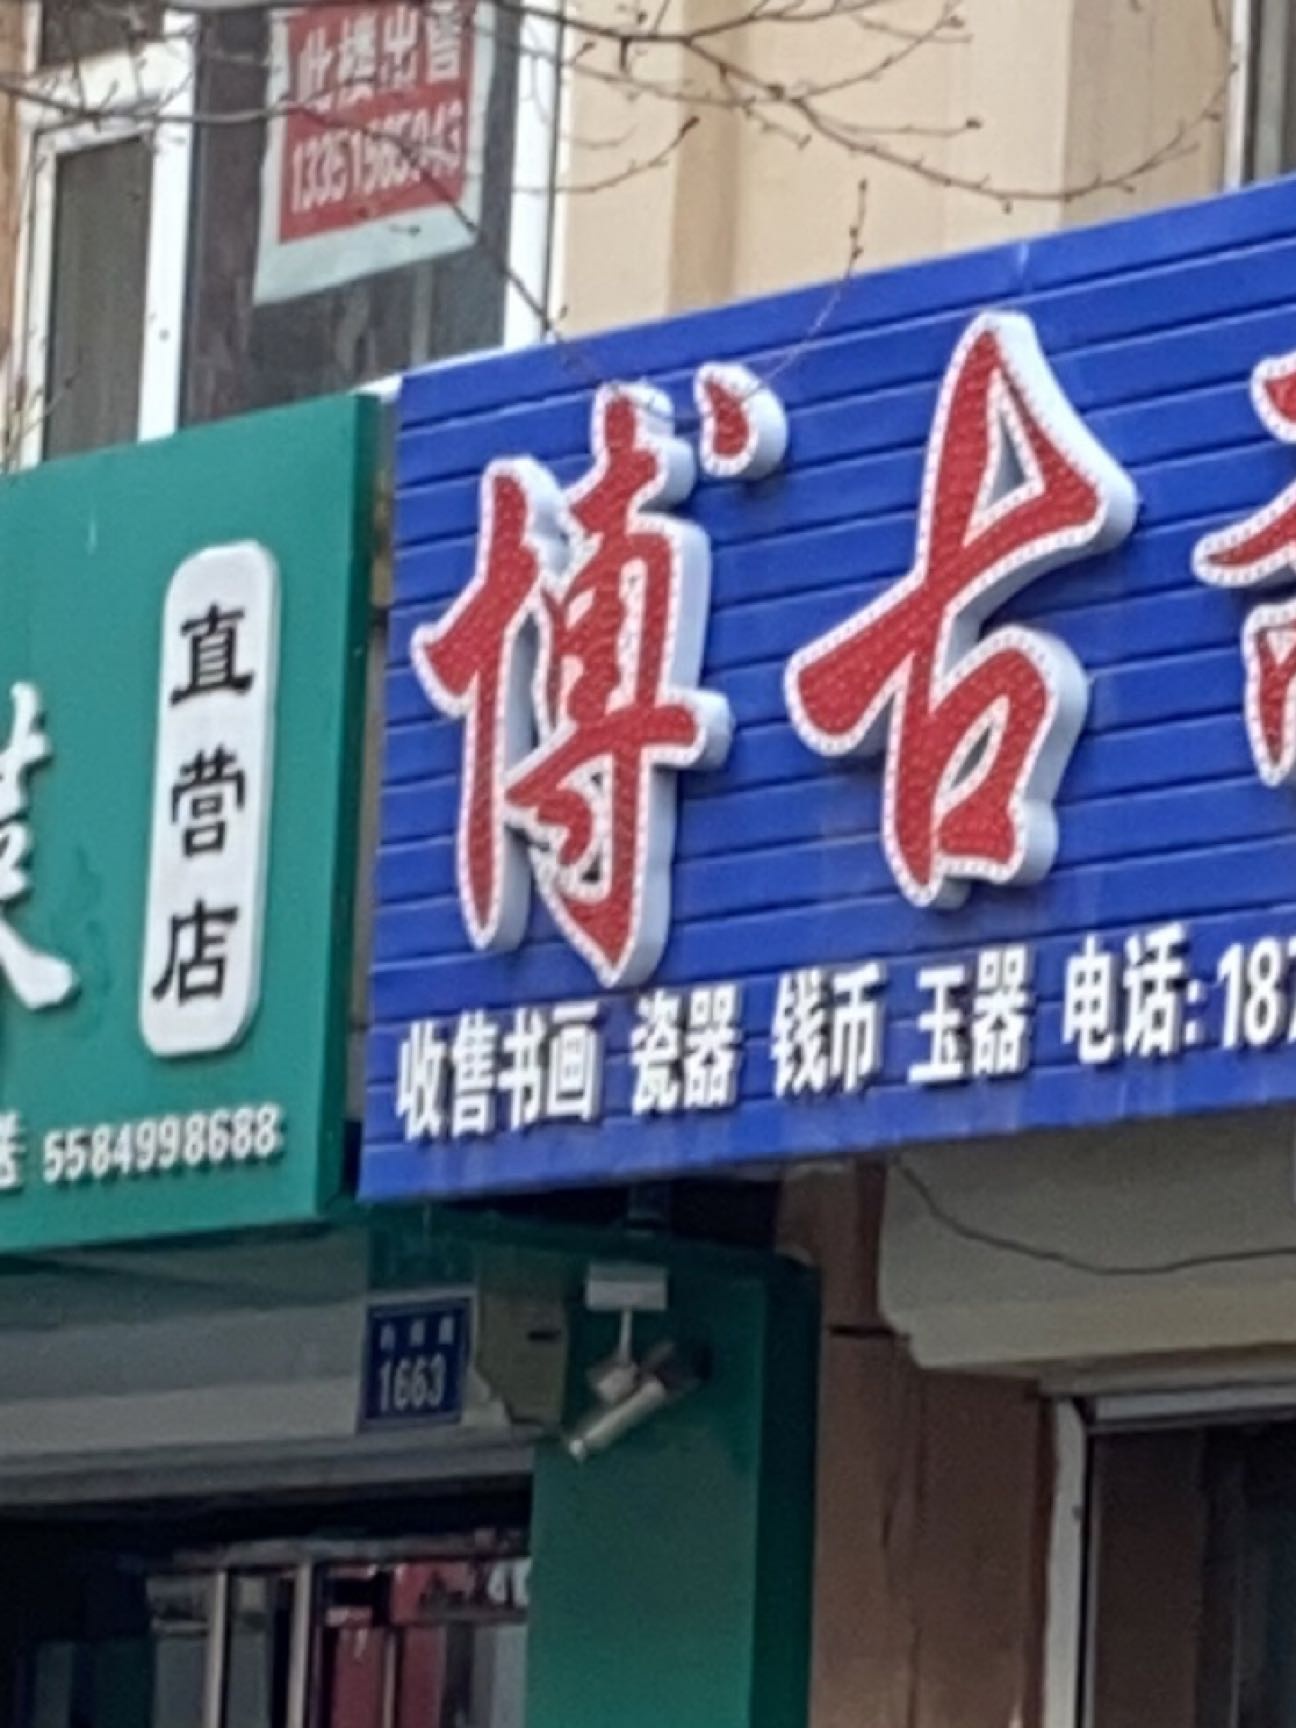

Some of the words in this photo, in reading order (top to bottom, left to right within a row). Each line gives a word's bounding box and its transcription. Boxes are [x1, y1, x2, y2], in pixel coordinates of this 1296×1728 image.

[152, 604, 257, 1006] 直营店
[396, 1001, 602, 1141] 收售书画
[631, 983, 743, 1115] 瓷器
[770, 961, 887, 1099] 钱币
[907, 946, 1030, 1083] 玉器
[43, 1102, 281, 1183] 5584998688
